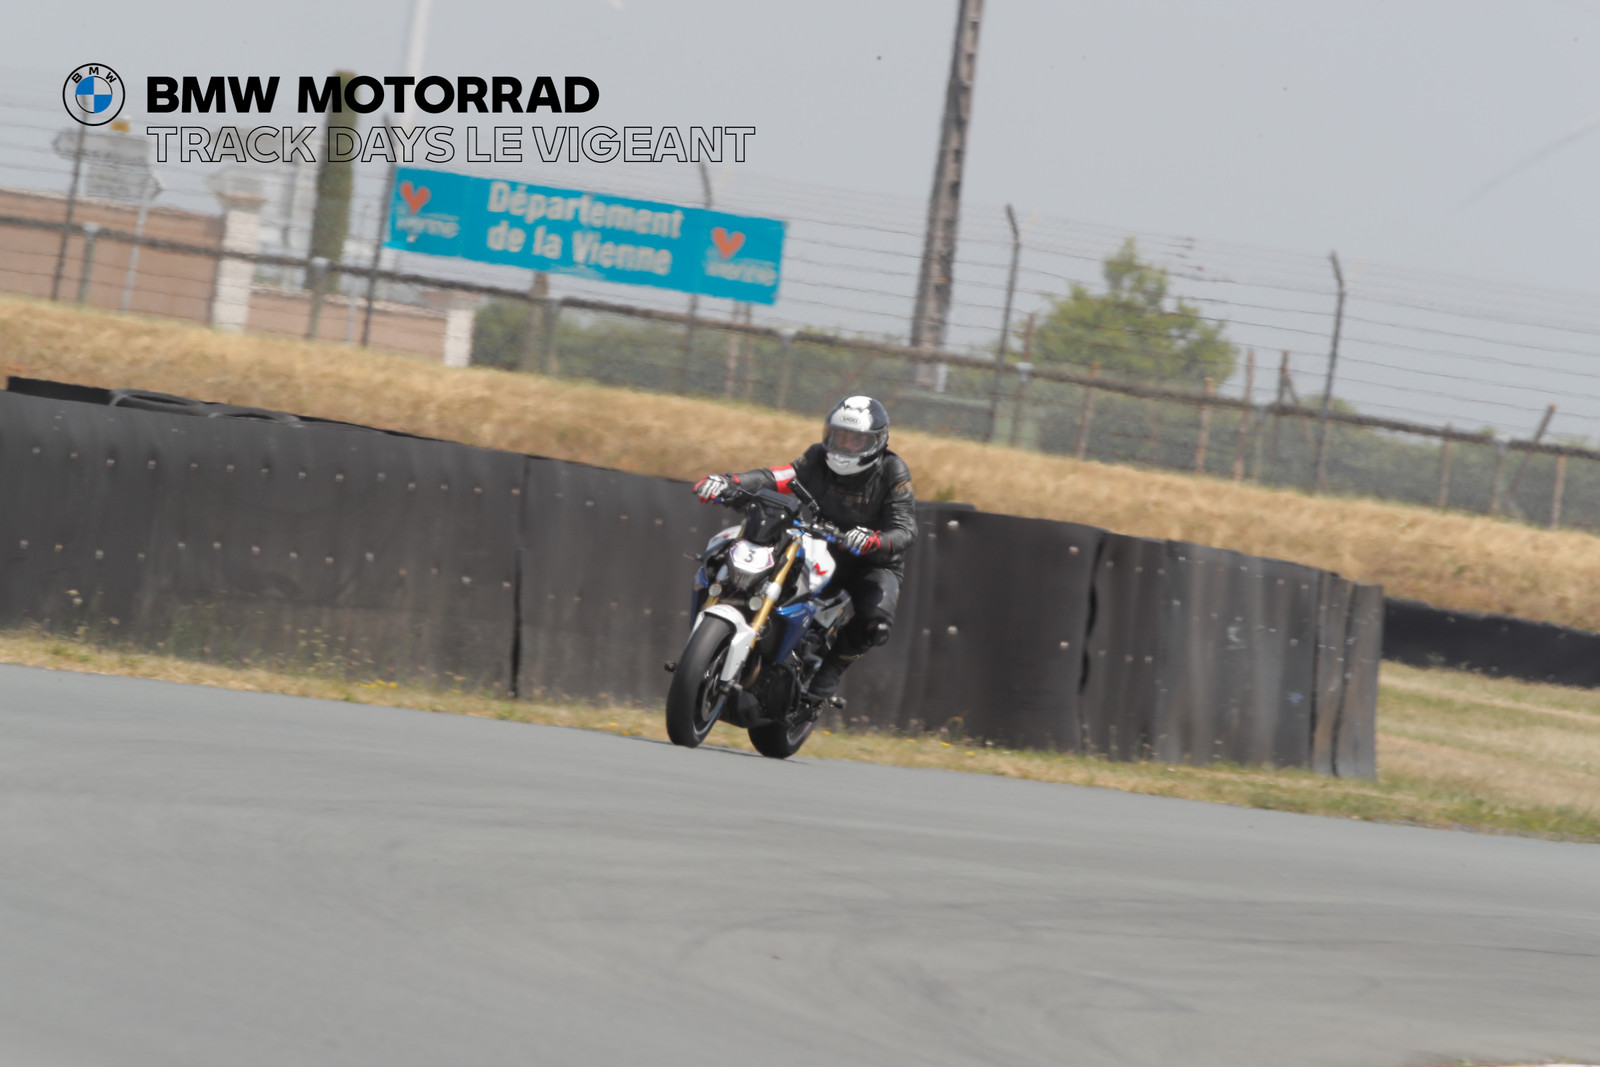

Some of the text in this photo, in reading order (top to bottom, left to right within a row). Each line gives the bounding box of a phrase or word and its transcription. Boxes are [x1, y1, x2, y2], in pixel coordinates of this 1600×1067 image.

[487, 180, 685, 239] Département
[486, 220, 527, 252] de
[531, 225, 563, 260] la
[571, 229, 673, 276] Vienne
[743, 549, 756, 563] 3
